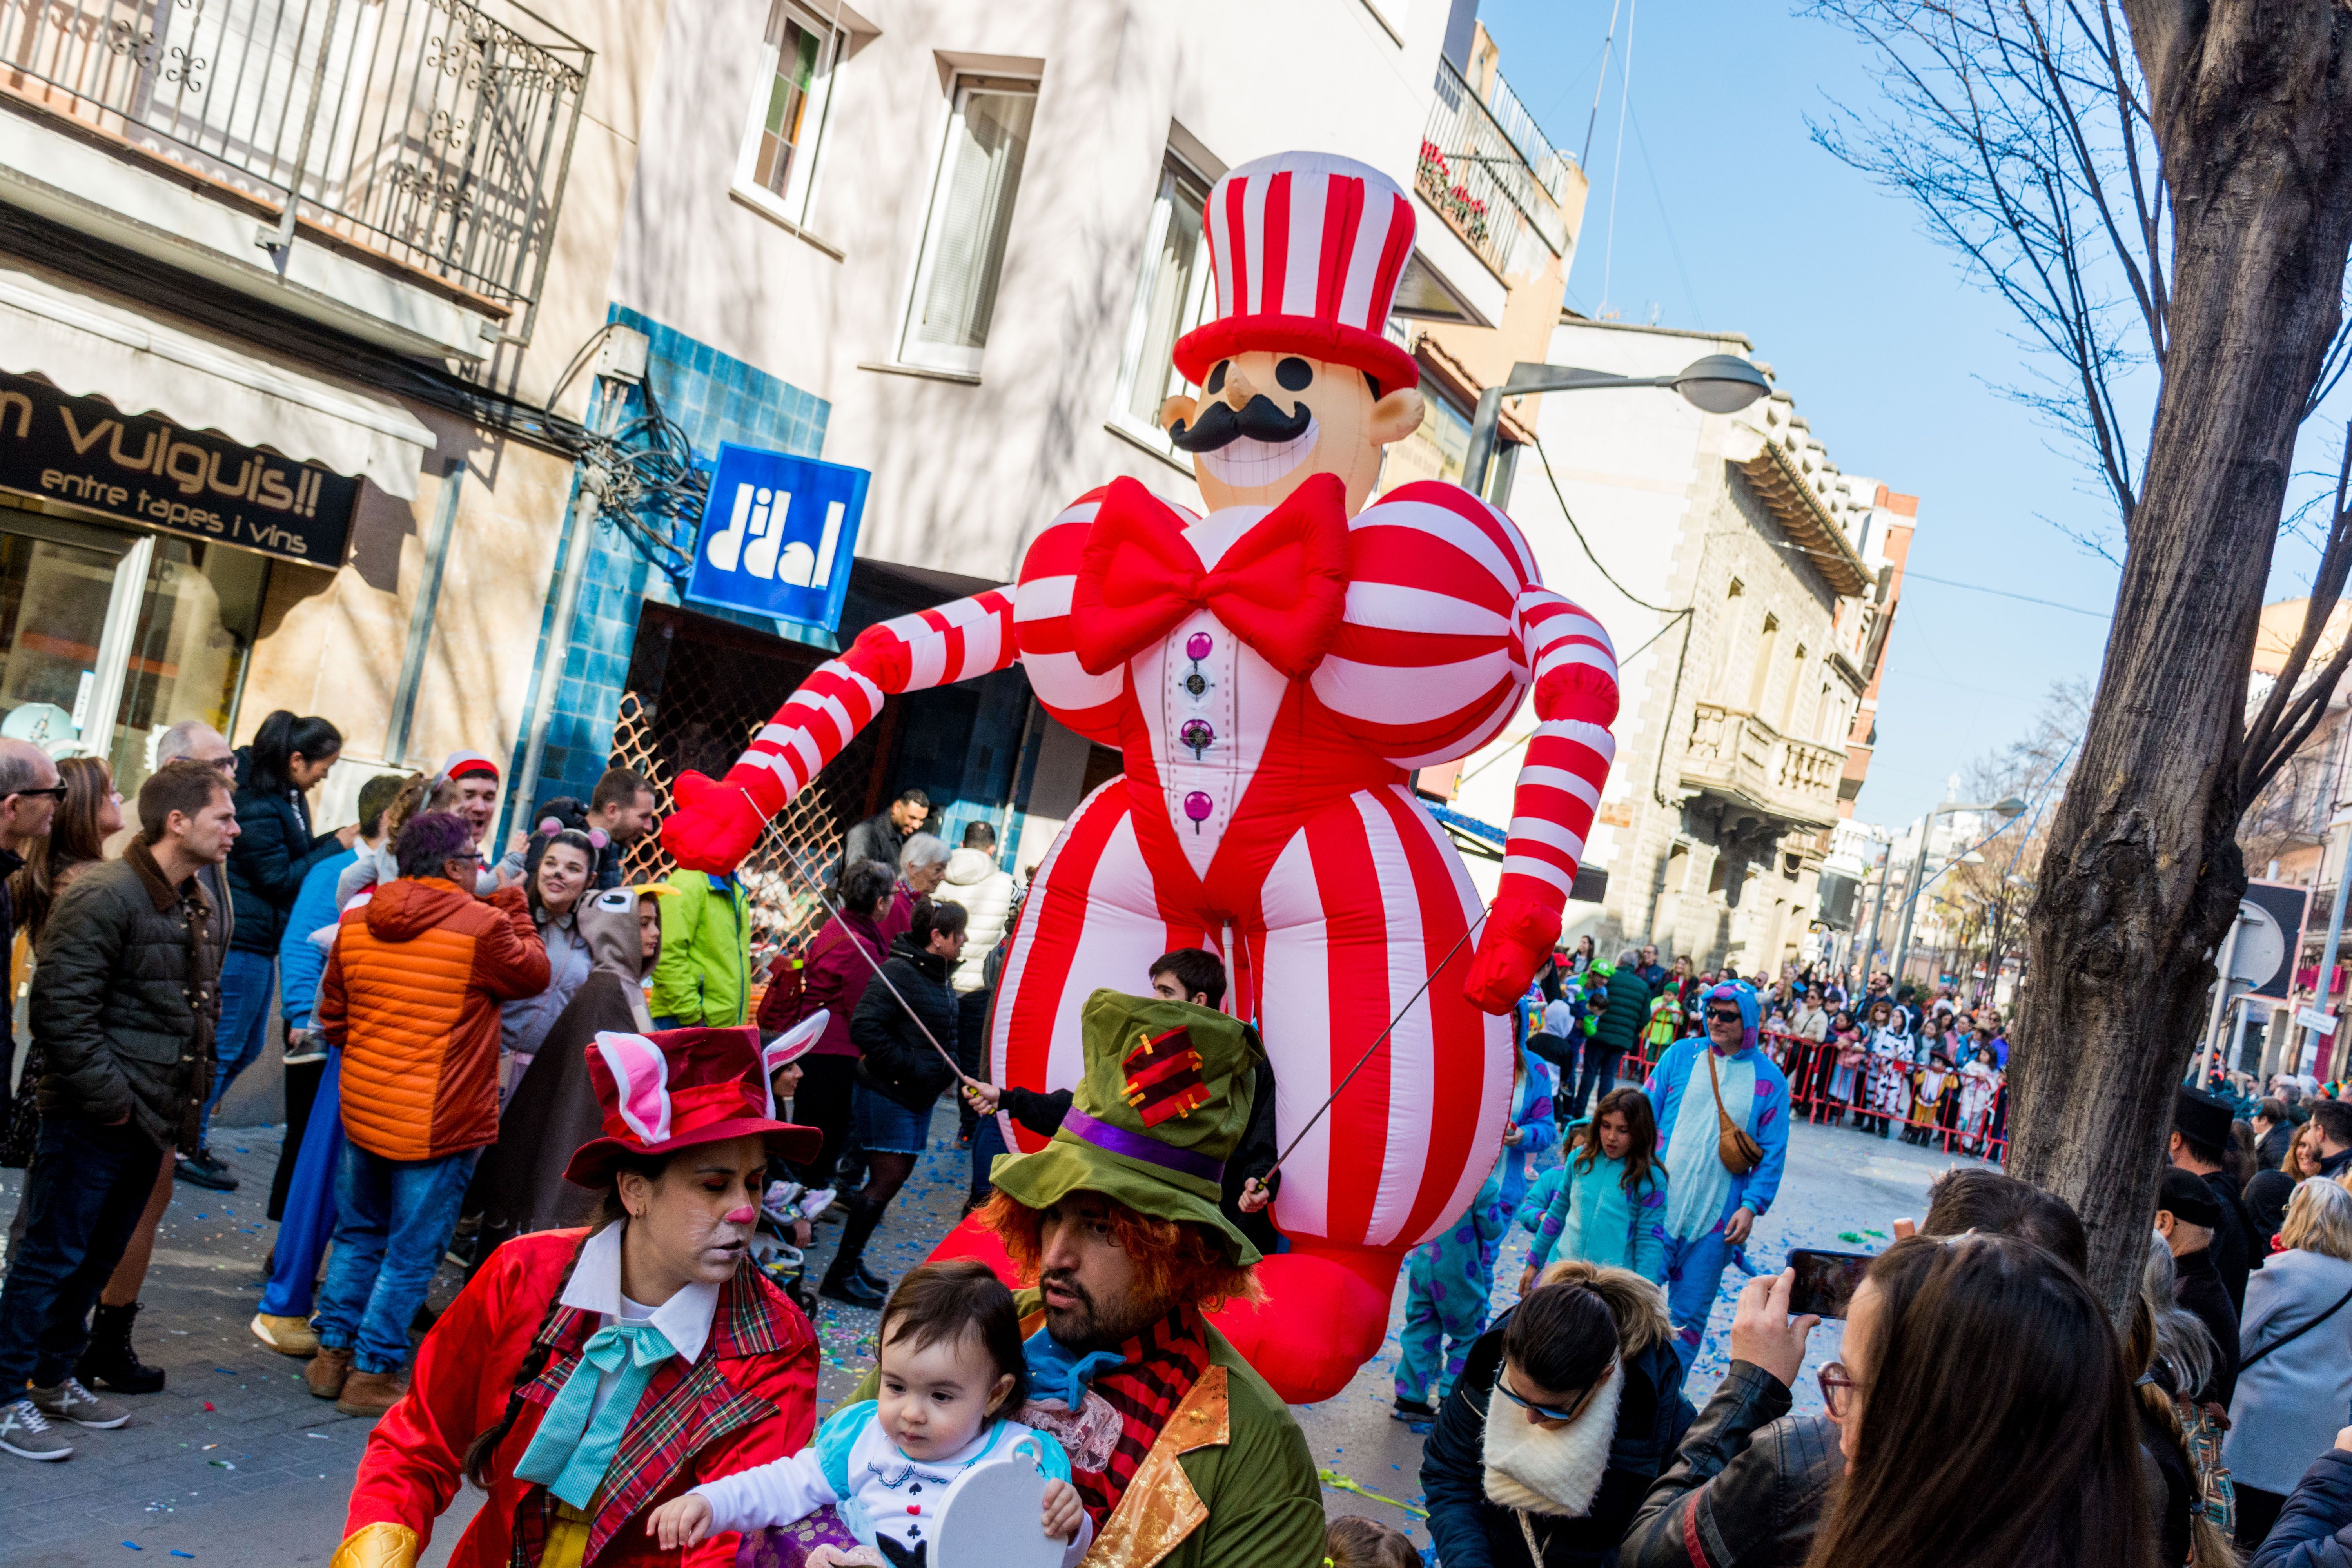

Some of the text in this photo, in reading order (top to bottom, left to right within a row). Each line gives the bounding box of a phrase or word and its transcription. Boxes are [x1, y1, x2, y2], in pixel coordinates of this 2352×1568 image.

[41, 468, 308, 554] entre tapes i vins
[59, 405, 323, 518] vulguis!!
[706, 482, 846, 590] didal
